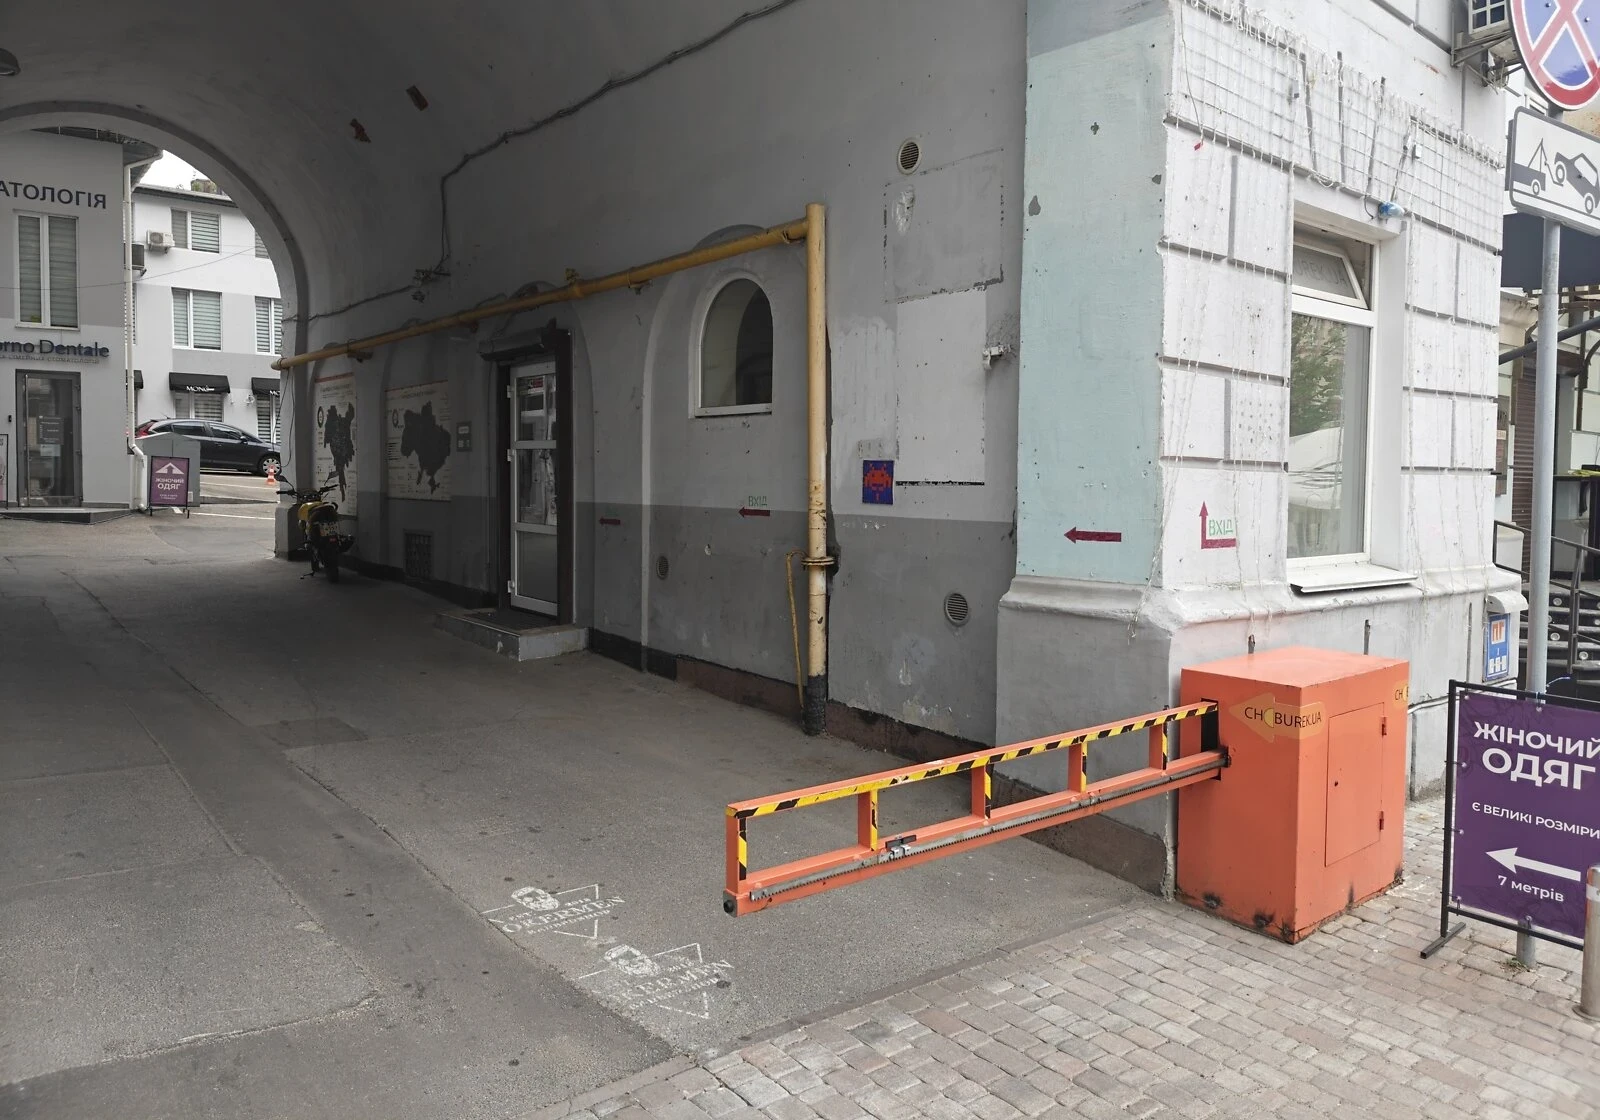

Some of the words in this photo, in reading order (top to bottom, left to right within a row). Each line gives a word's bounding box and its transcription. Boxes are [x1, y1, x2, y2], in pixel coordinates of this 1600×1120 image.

[0, 341, 34, 353] rno
[39, 339, 109, 357] Dentale
[1208, 519, 1234, 536] ВХІД
[1482, 748, 1596, 790] ОДЯГ
[1472, 802, 1481, 811] Є
[1484, 804, 1532, 824] ВЕЛИКІ
[1535, 816, 1600, 839] РОЗМІРИ
[1498, 875, 1507, 886] 7
[1511, 881, 1564, 902] метрів
